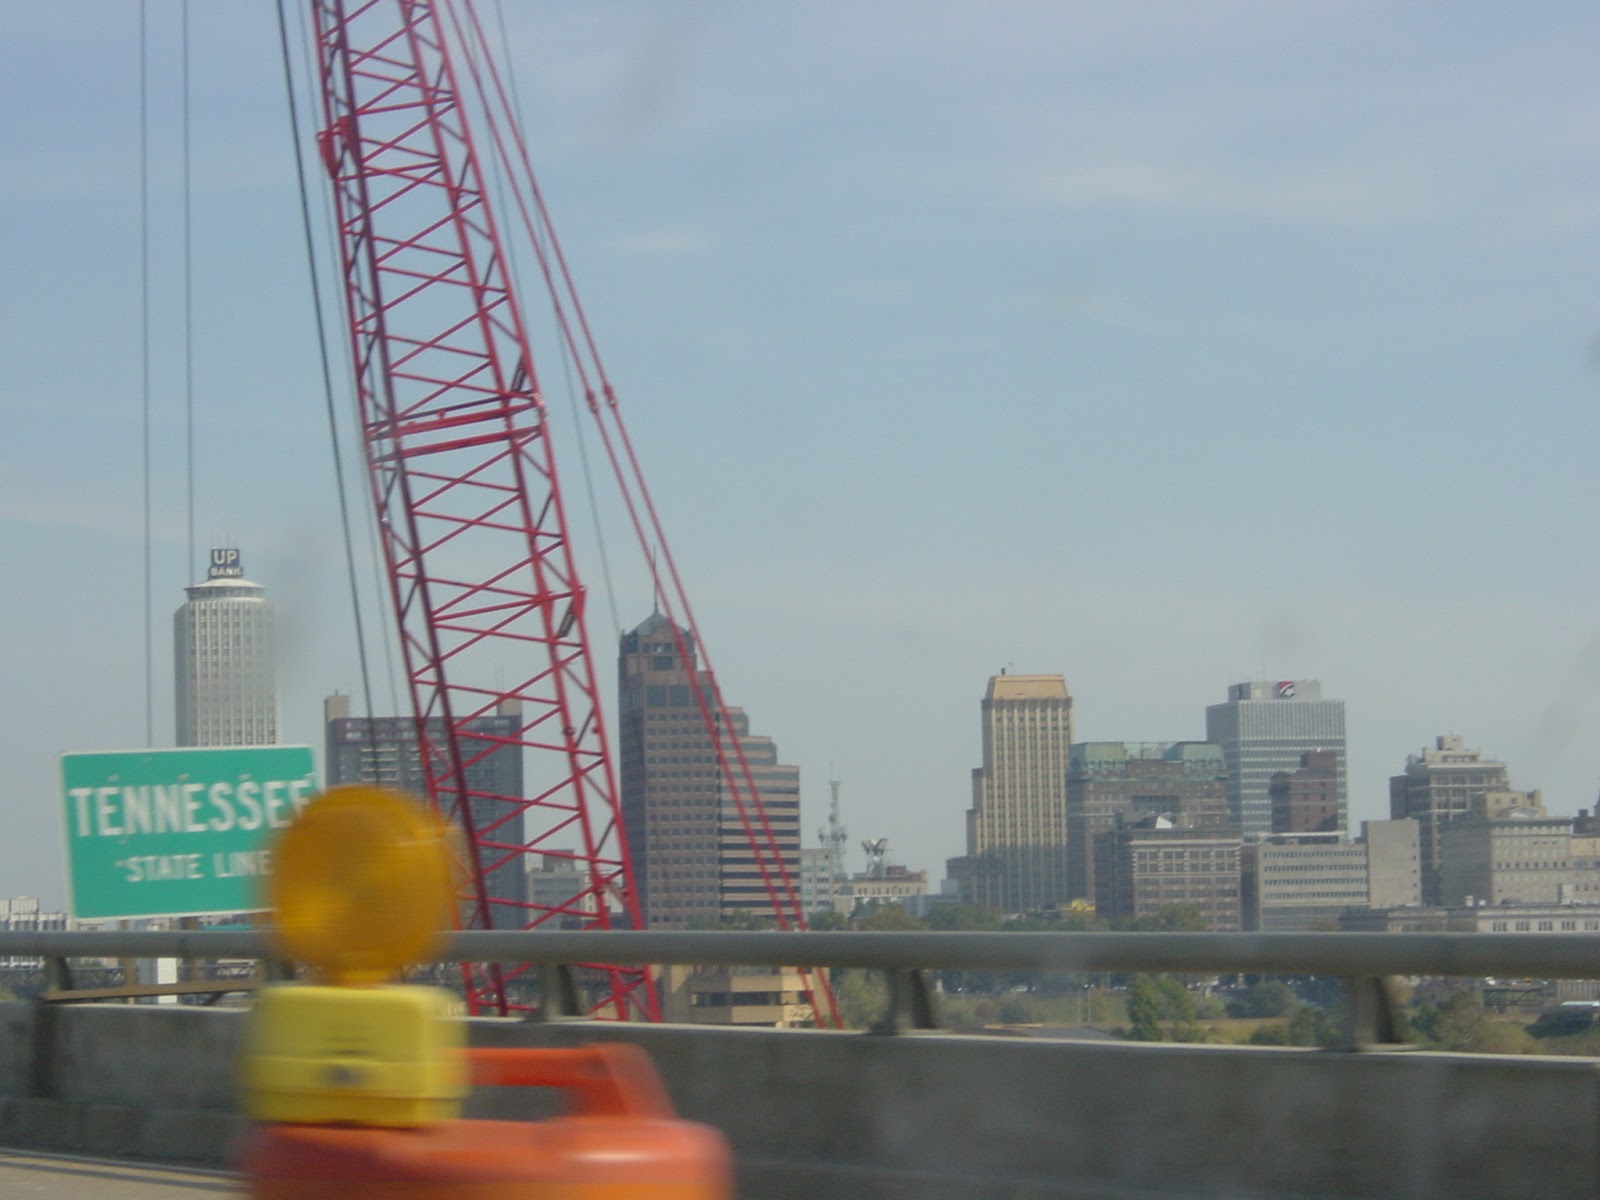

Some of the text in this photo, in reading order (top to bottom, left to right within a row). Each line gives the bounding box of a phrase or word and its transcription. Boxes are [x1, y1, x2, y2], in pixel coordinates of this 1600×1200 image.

[213, 550, 238, 565] UP
[210, 567, 242, 576] BANK
[125, 850, 274, 882] STATE LINE
